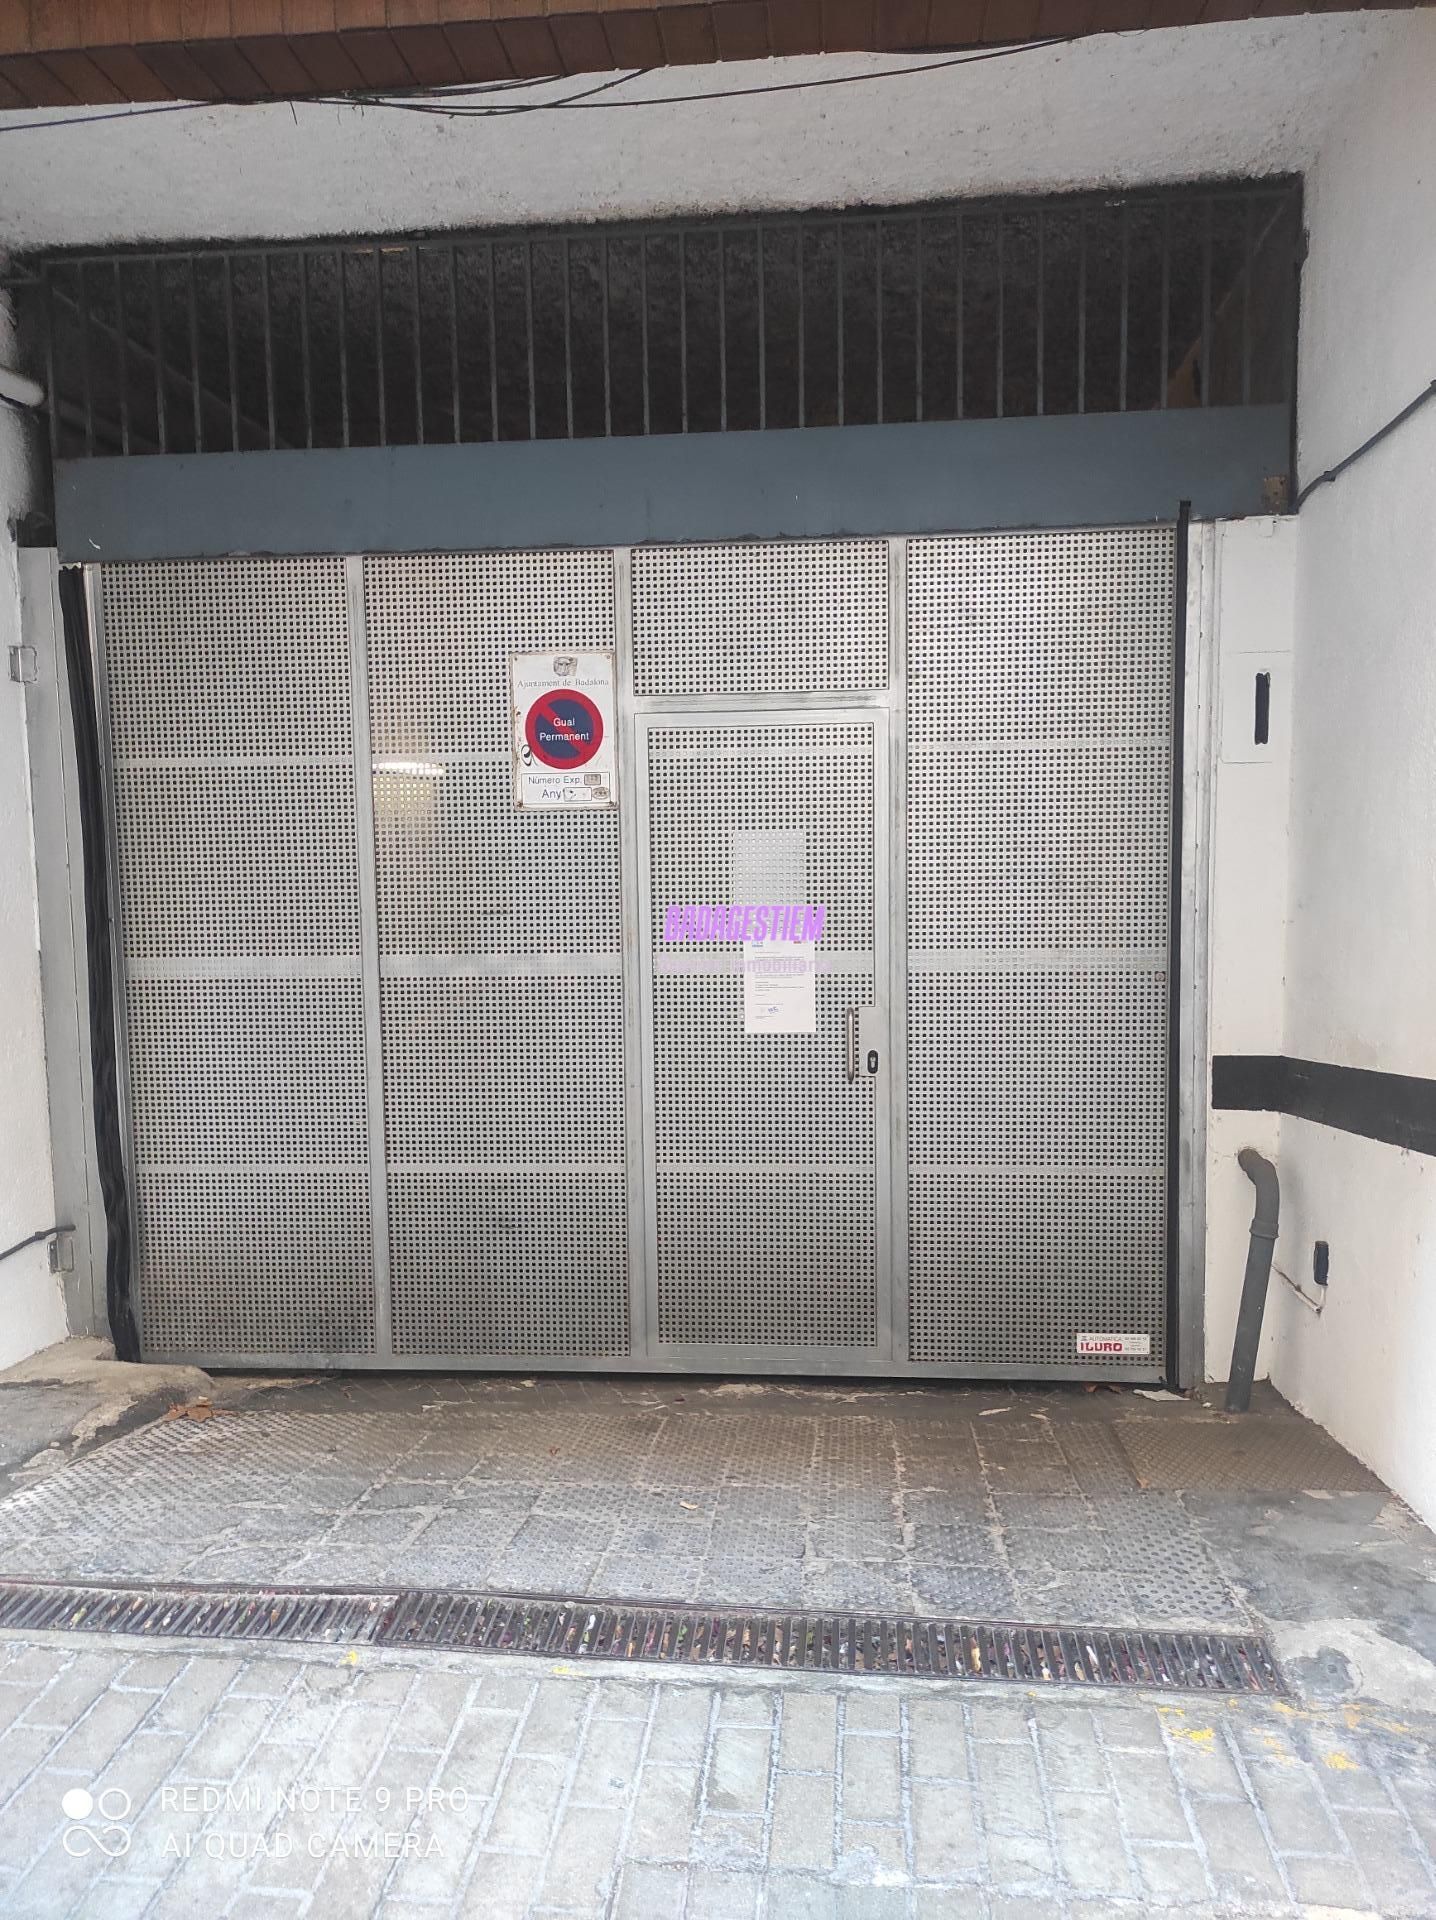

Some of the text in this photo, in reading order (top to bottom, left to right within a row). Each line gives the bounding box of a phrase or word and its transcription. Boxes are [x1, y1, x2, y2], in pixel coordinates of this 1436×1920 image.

[518, 680, 560, 688] Ajuntament
[575, 679, 609, 687] Badalona
[553, 717, 575, 727] Gual
[539, 732, 590, 742] Permanent
[541, 788, 562, 800] Any
[1080, 1342, 1123, 1352] ILURO
